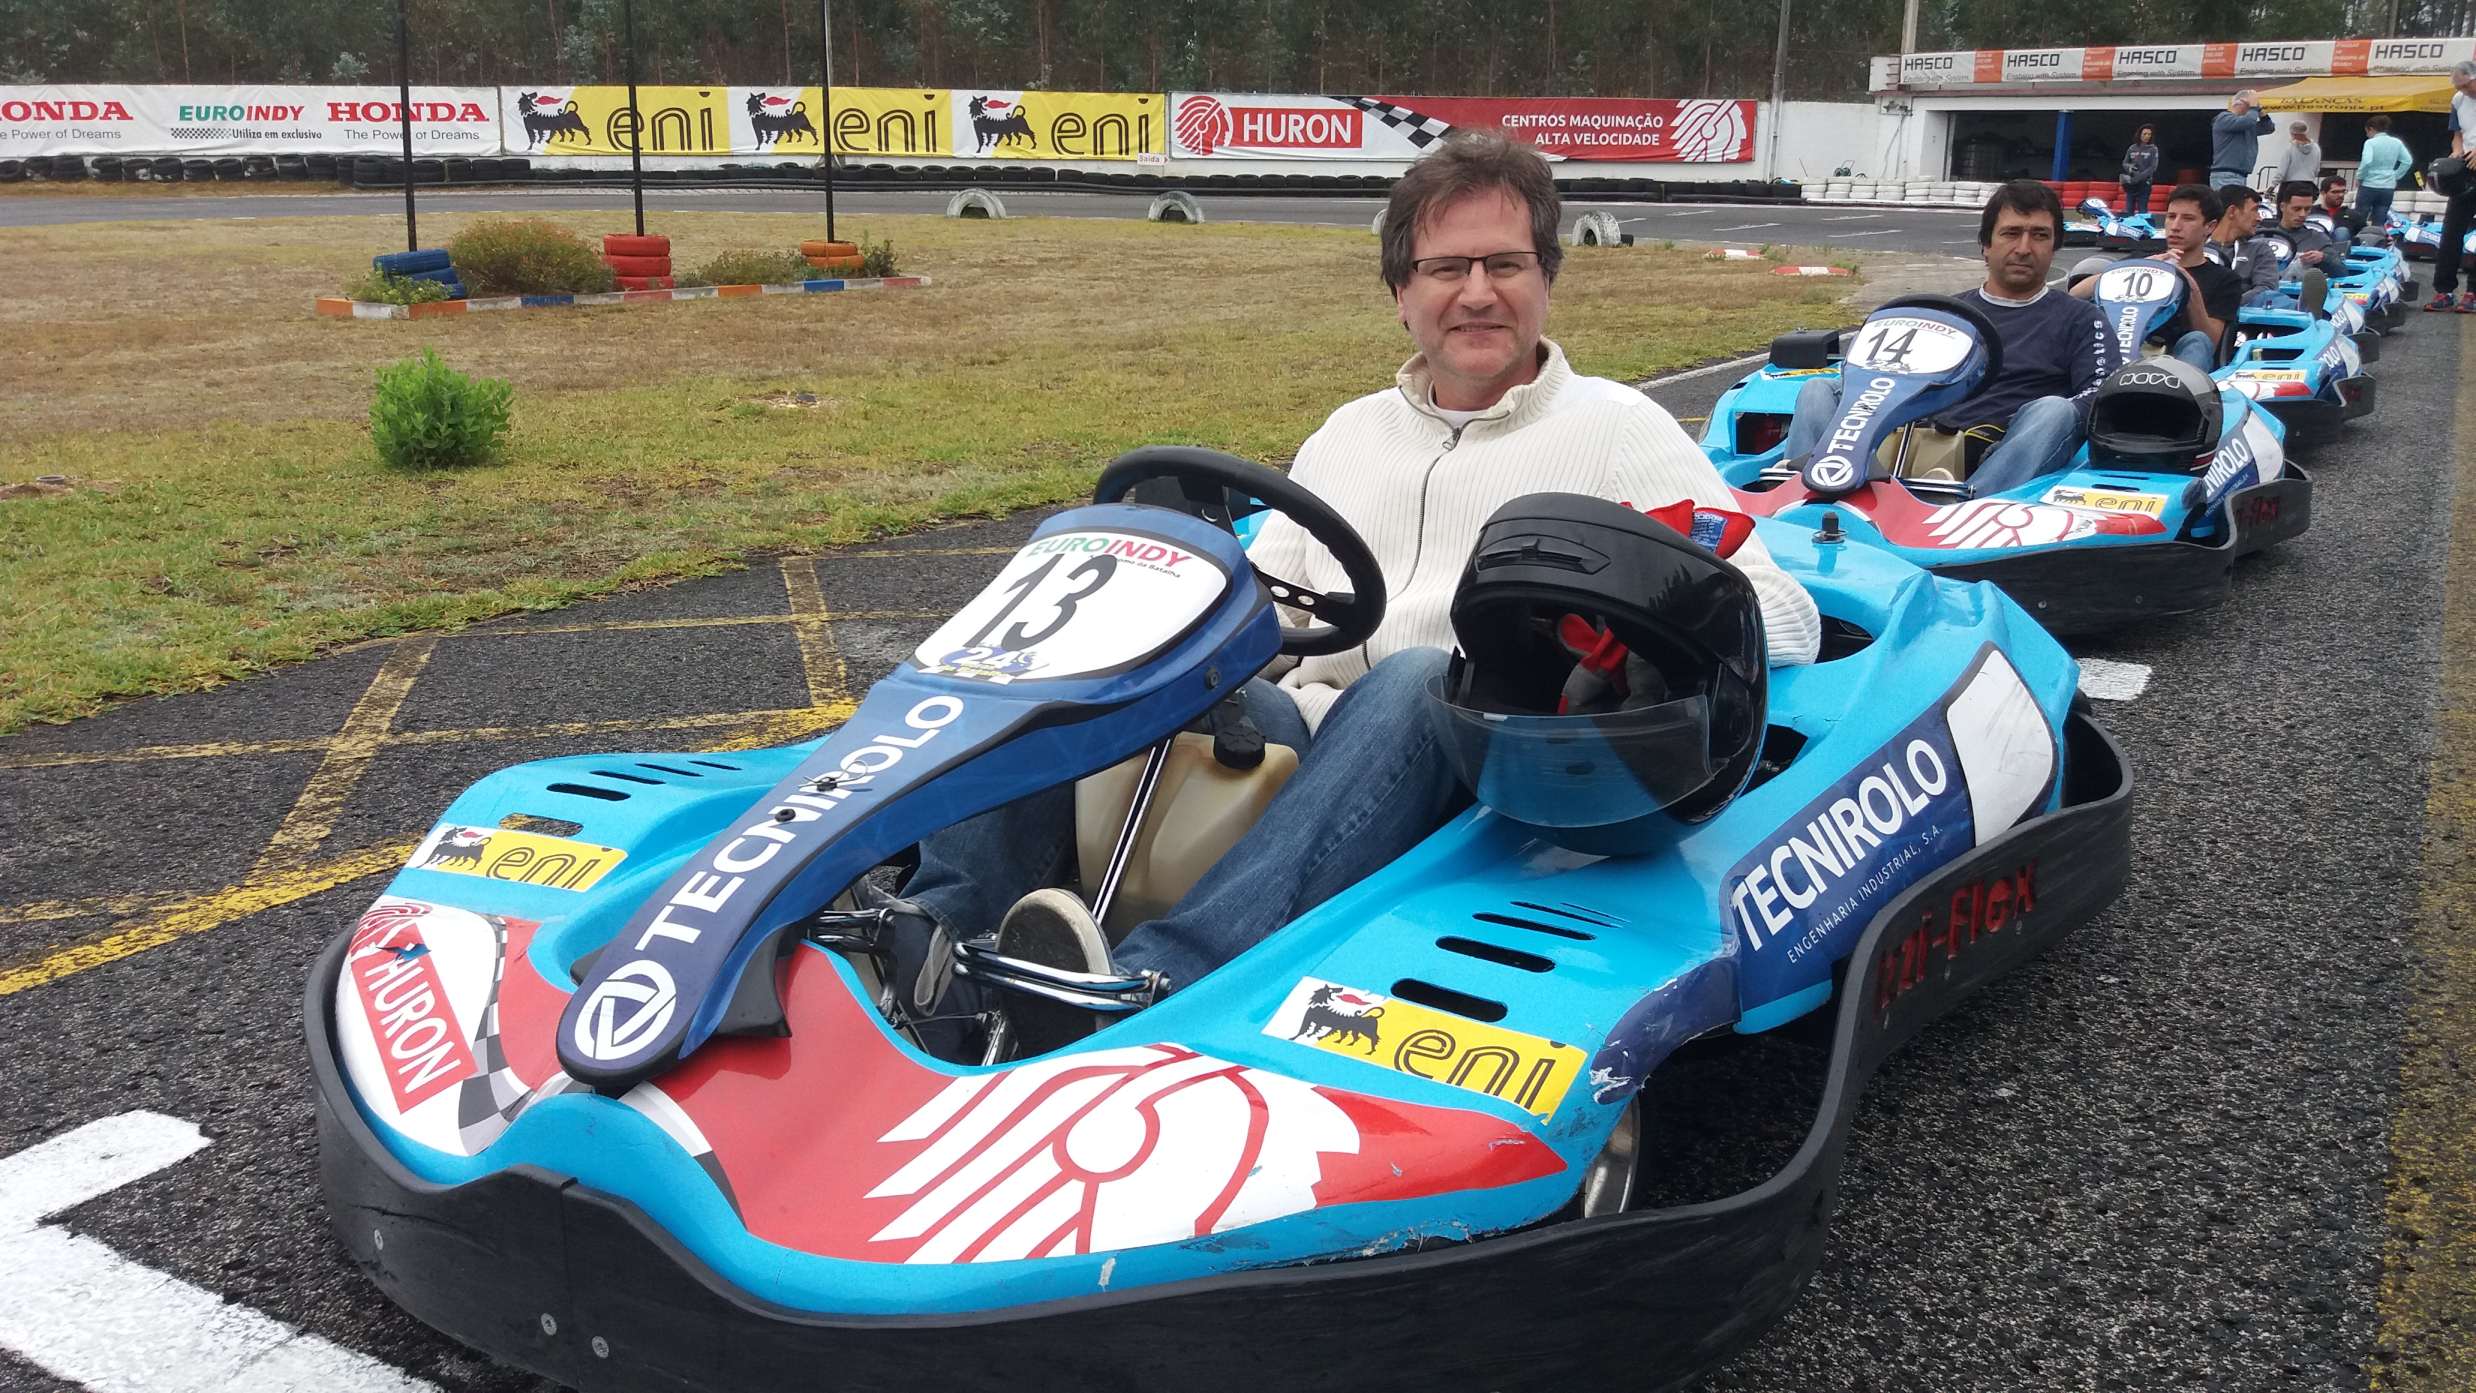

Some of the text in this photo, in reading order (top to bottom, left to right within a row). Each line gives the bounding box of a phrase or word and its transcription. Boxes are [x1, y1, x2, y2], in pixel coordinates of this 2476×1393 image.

[2007, 54, 2061, 68] HASCO
[2119, 50, 2177, 64] HASCO
[2242, 46, 2306, 62] HASCO
[2375, 43, 2445, 60] HASCO
[1904, 57, 1953, 71] HASCO
[0, 101, 134, 121] ONDA
[178, 105, 304, 121] EUROINDY
[327, 101, 490, 122] HONDA
[606, 91, 714, 151] eni
[1502, 112, 1663, 130] CENTROS MAQUINAÇÃO
[12, 129, 50, 140] Power
[56, 128, 68, 139] of
[72, 128, 121, 139] Dreams
[232, 128, 322, 139] Utiliza em exclusivo
[344, 129, 480, 140] The Powe of Dreams
[833, 93, 937, 153] eni
[1051, 97, 1150, 156] eni
[1243, 112, 1352, 144] HURON
[1535, 132, 1660, 145] ALTA VELOCIDADE
[2122, 272, 2153, 298] 10
[1874, 319, 1958, 336] EUROINDY
[1865, 328, 1918, 365] 14
[1826, 377, 1896, 454] TECNIROLO
[2203, 438, 2249, 497] NIROLO
[2095, 496, 2159, 513] eni
[1026, 537, 1193, 568] EUROINDY
[1149, 563, 1181, 579] Batalha
[962, 553, 1118, 652] 13
[634, 695, 965, 952] TECNIROLO
[1732, 739, 1947, 952] TECNIROLO
[486, 846, 613, 890] eni
[1786, 824, 1944, 964] ENGENHARIA INDUSTRIAL, S.A.
[364, 943, 462, 1095] HURON
[1393, 1029, 1567, 1110] eni
